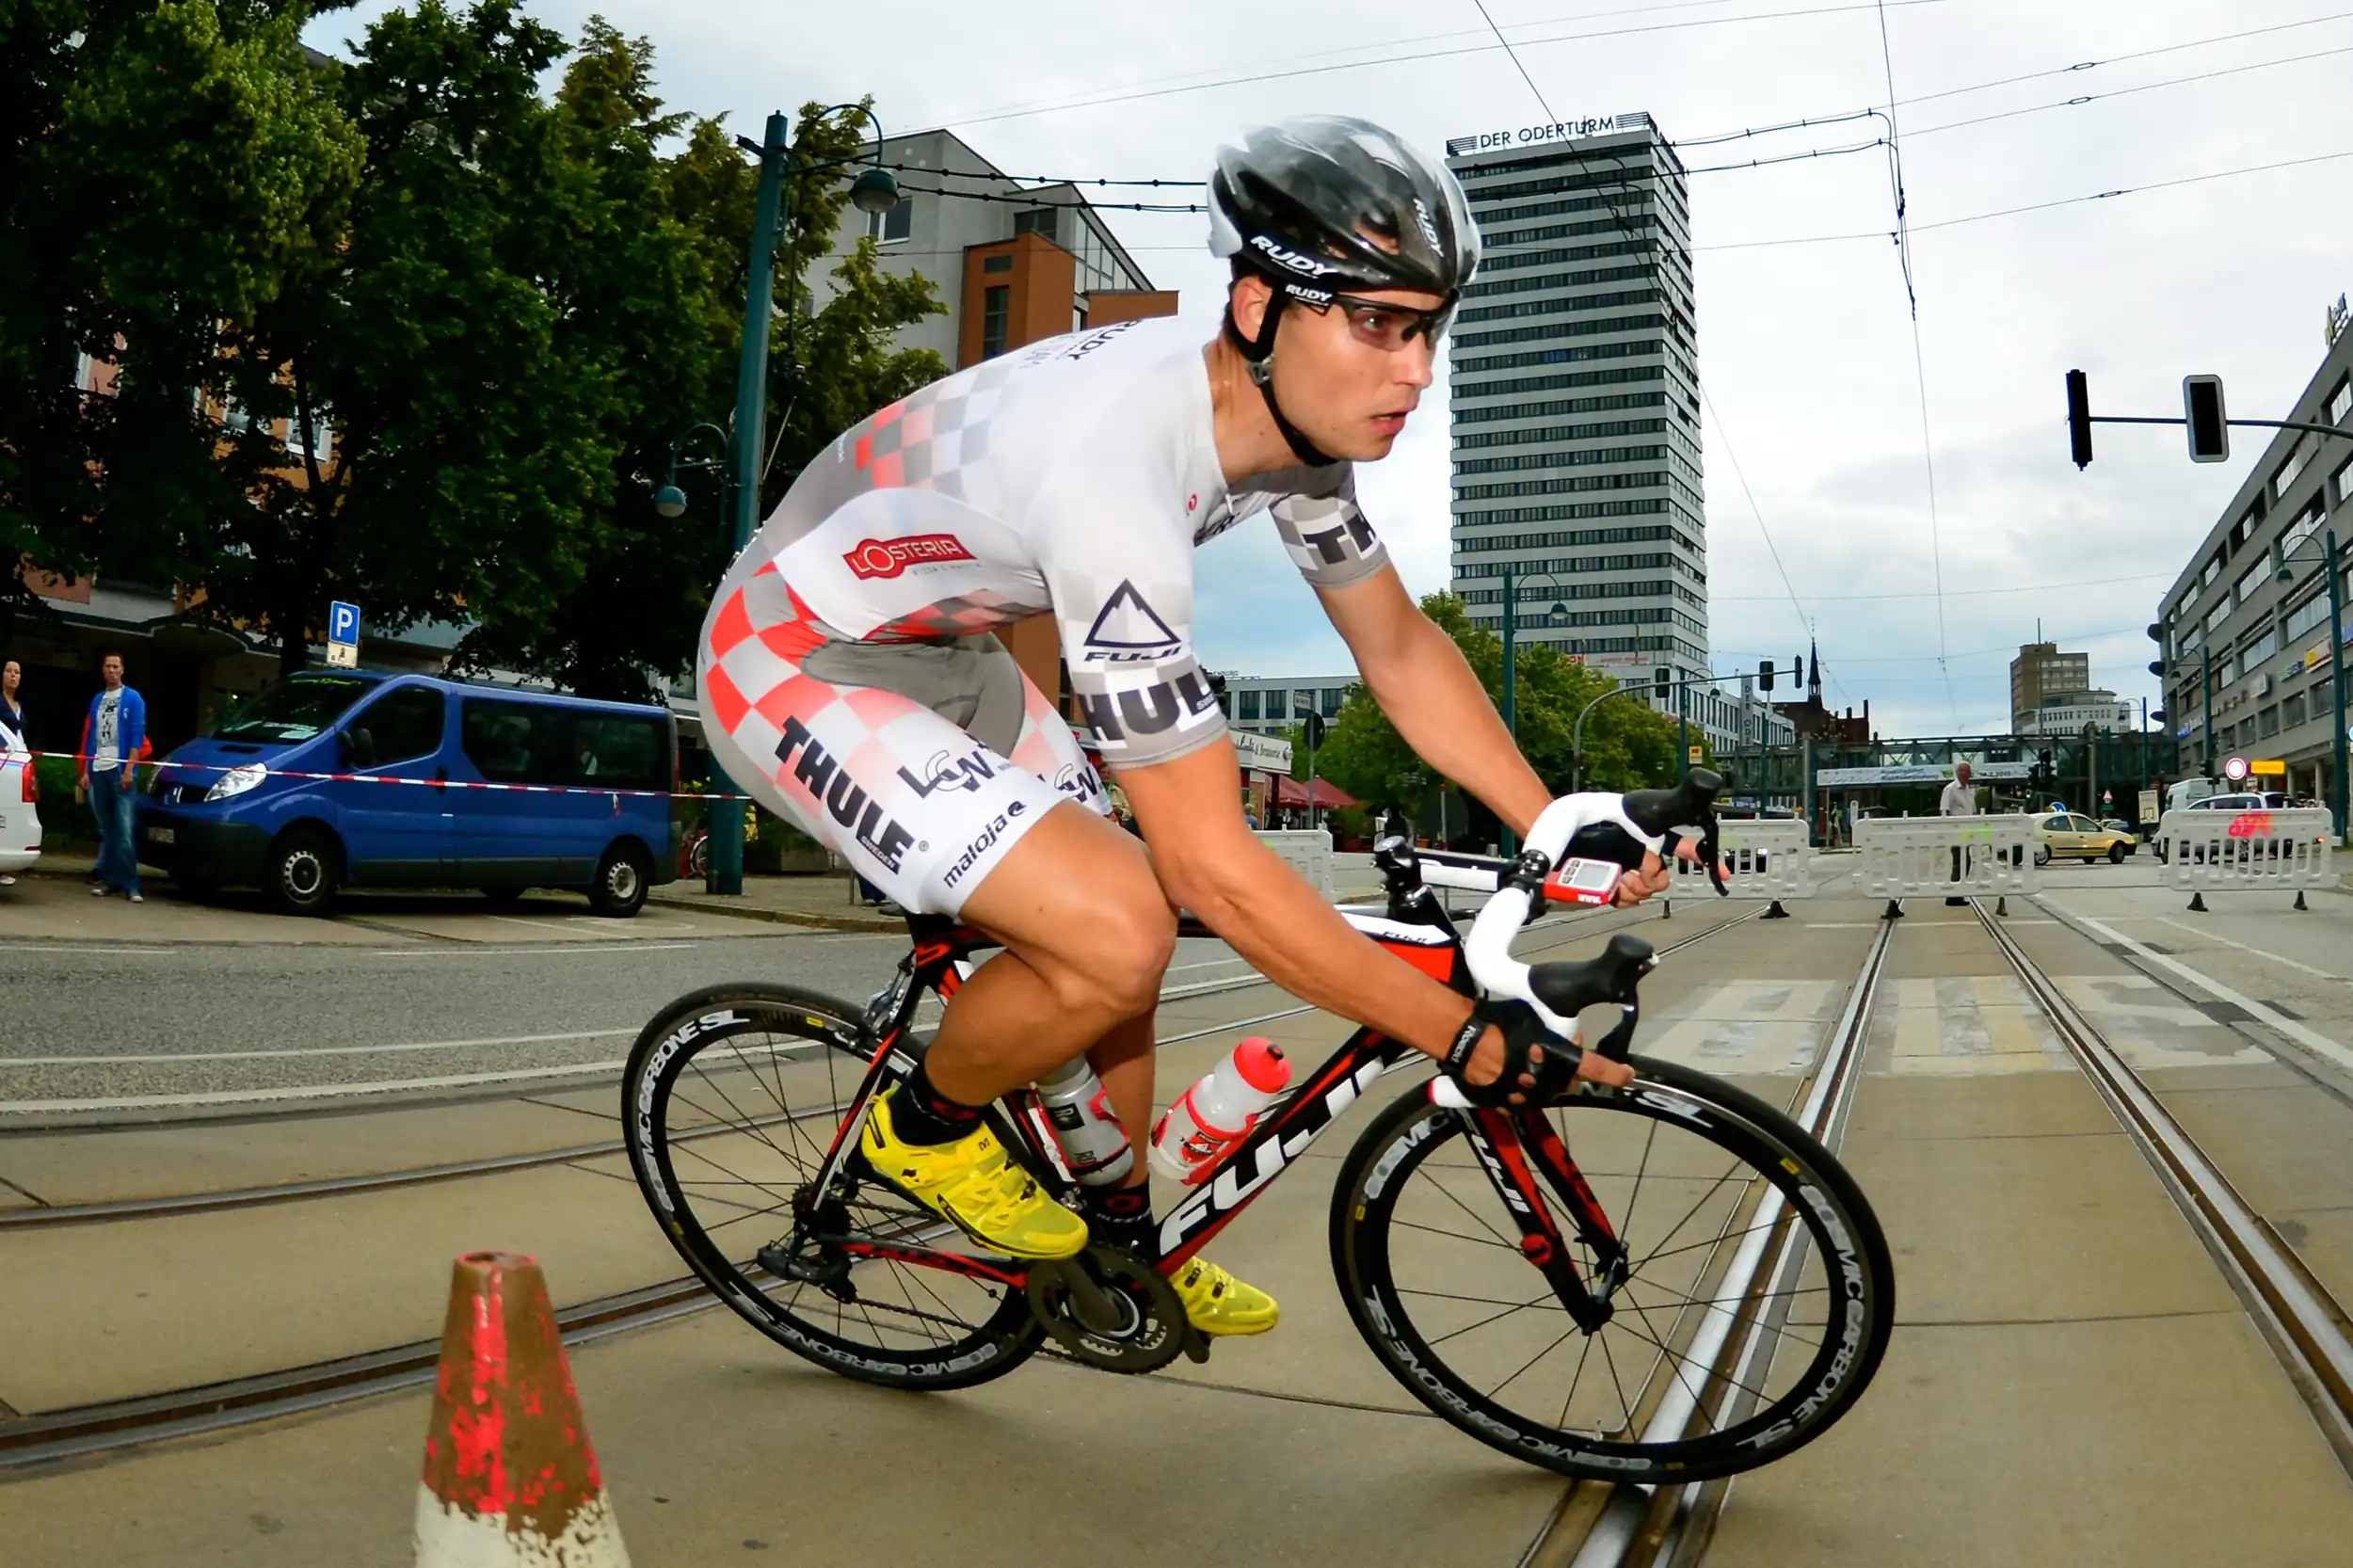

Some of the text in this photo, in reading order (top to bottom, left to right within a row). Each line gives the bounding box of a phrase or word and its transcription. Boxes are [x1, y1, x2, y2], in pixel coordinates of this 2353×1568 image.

[1480, 116, 1614, 149] DER ODERTURM
[1413, 198, 1445, 258] RUDY
[1250, 235, 1338, 276] RUDY
[1285, 284, 1333, 301] RUDY
[337, 608, 353, 637] P
[1084, 646, 1181, 662] FUJI
[1077, 672, 1216, 741] HUL
[775, 715, 915, 875] THULE
[860, 835, 896, 868] SWEDEN
[943, 813, 1009, 888] maloja
[1160, 1055, 1385, 1256] FUJI
